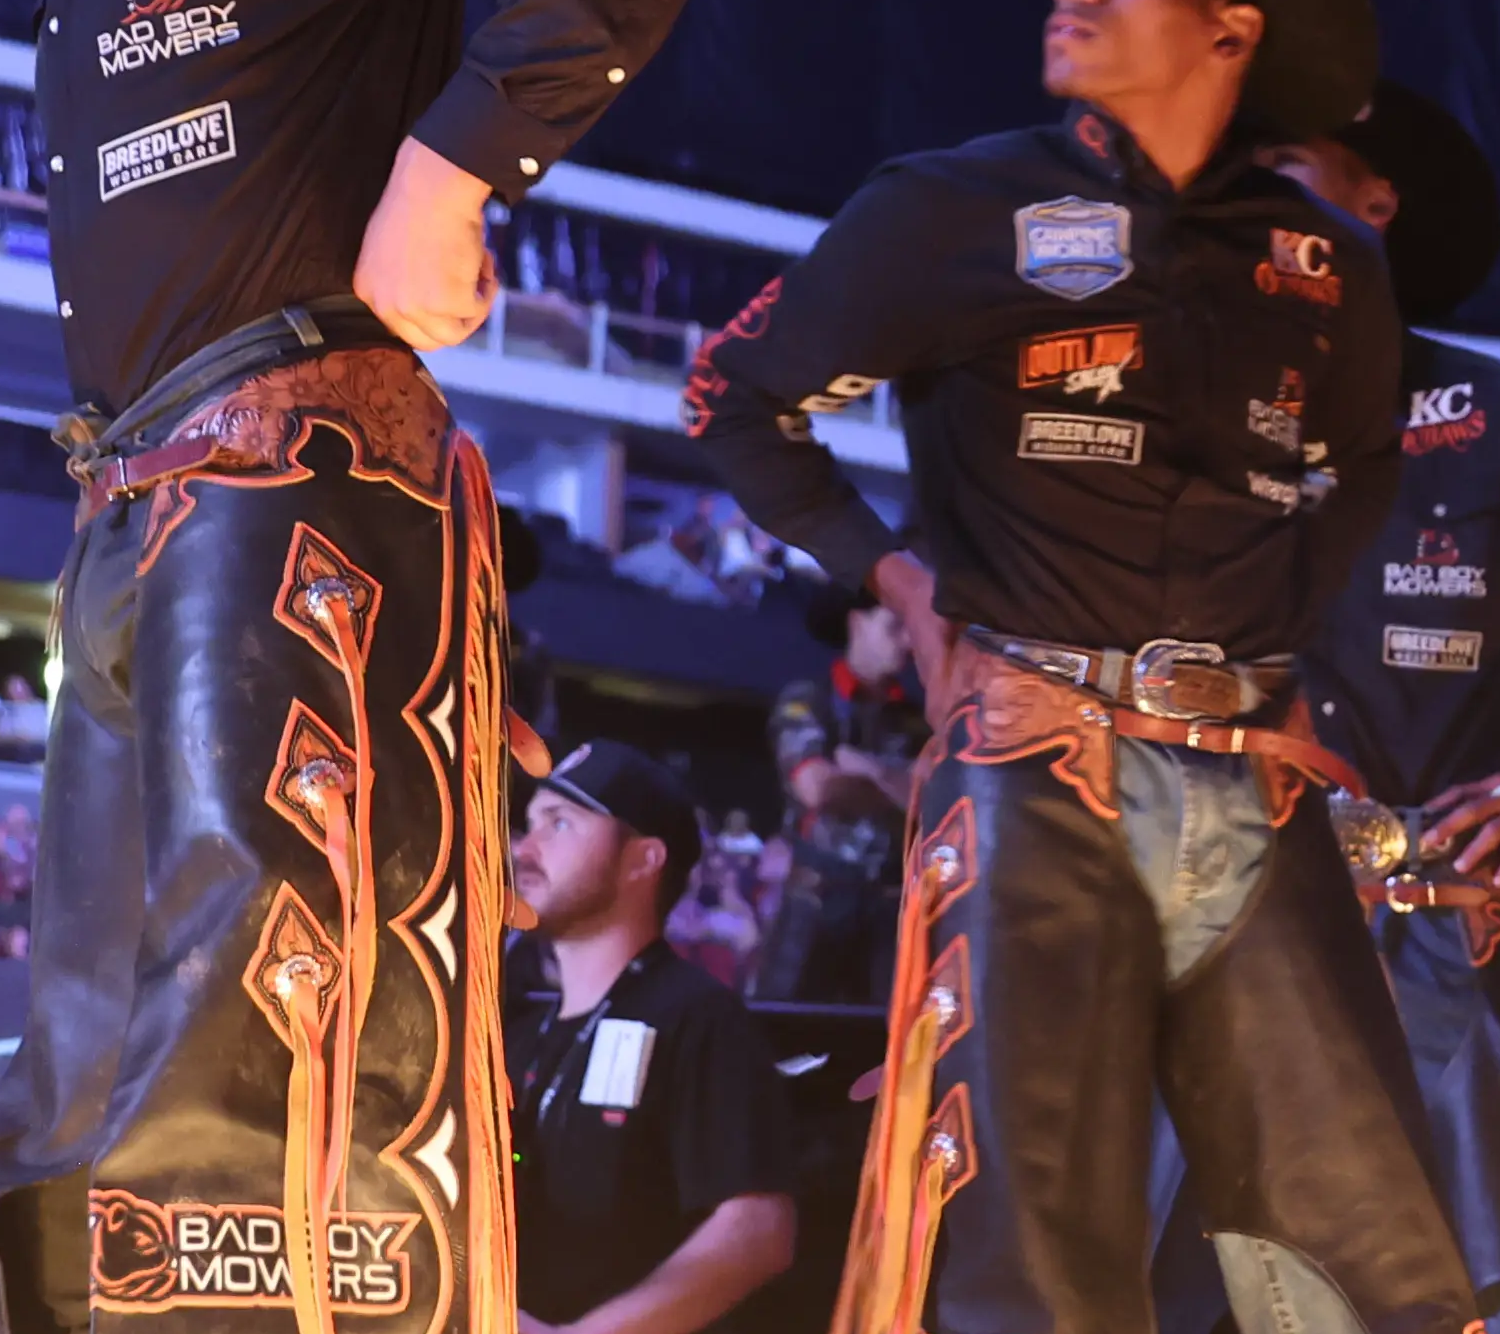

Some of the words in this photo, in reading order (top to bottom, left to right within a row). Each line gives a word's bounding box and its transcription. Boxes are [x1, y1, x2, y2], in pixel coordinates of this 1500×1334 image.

[97, 19, 155, 56] BAD
[163, 0, 237, 35] BOY
[99, 21, 241, 79] MOWERS
[104, 113, 225, 176] BREEDLOVE
[109, 159, 165, 188] WOUND
[172, 142, 219, 167] CARE
[1406, 382, 1474, 428] KC
[1384, 562, 1433, 581] BAD
[1437, 565, 1486, 581] BOY
[179, 1217, 281, 1254] BAD
